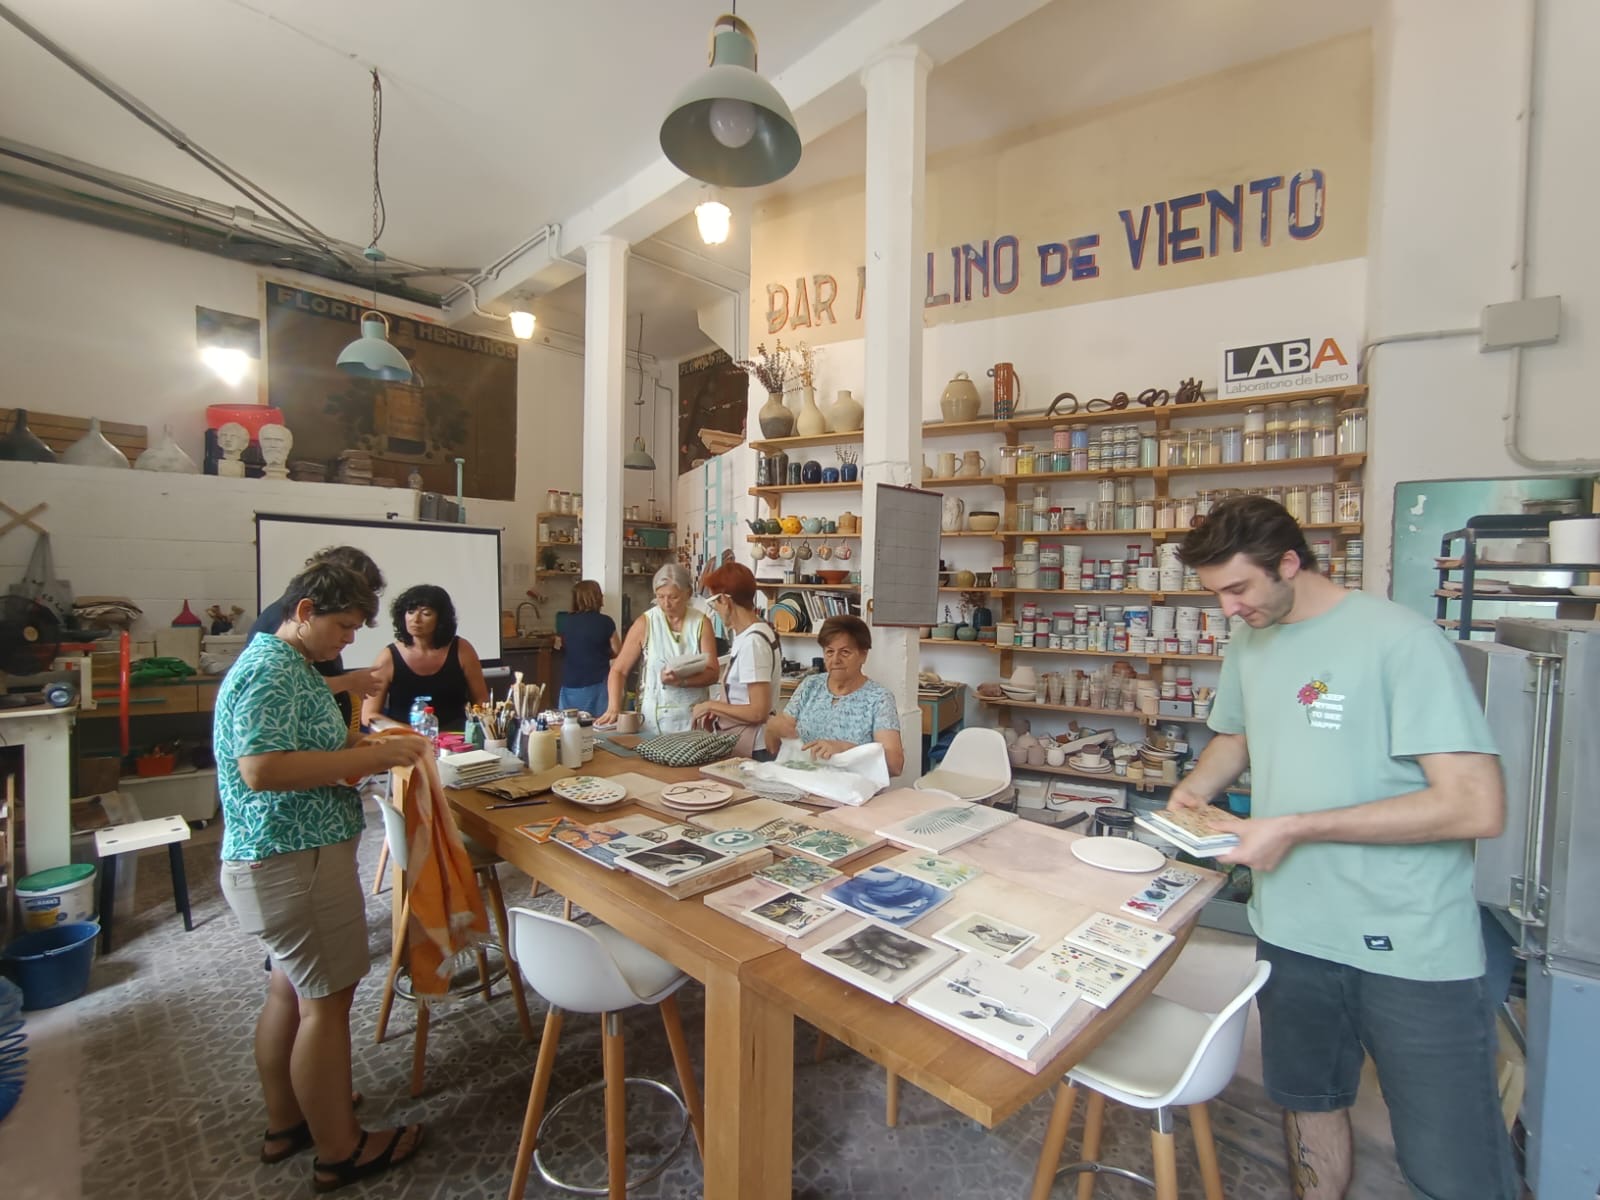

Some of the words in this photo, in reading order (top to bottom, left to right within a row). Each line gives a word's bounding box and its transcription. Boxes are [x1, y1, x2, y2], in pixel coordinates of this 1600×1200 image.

[1037, 234, 1100, 287] DE
[1118, 168, 1325, 270] VIENTO
[1226, 337, 1348, 381] LABA
[1226, 379, 1293, 394] Laboratorio
[1295, 374, 1312, 386] de
[1315, 372, 1348, 384] barro
